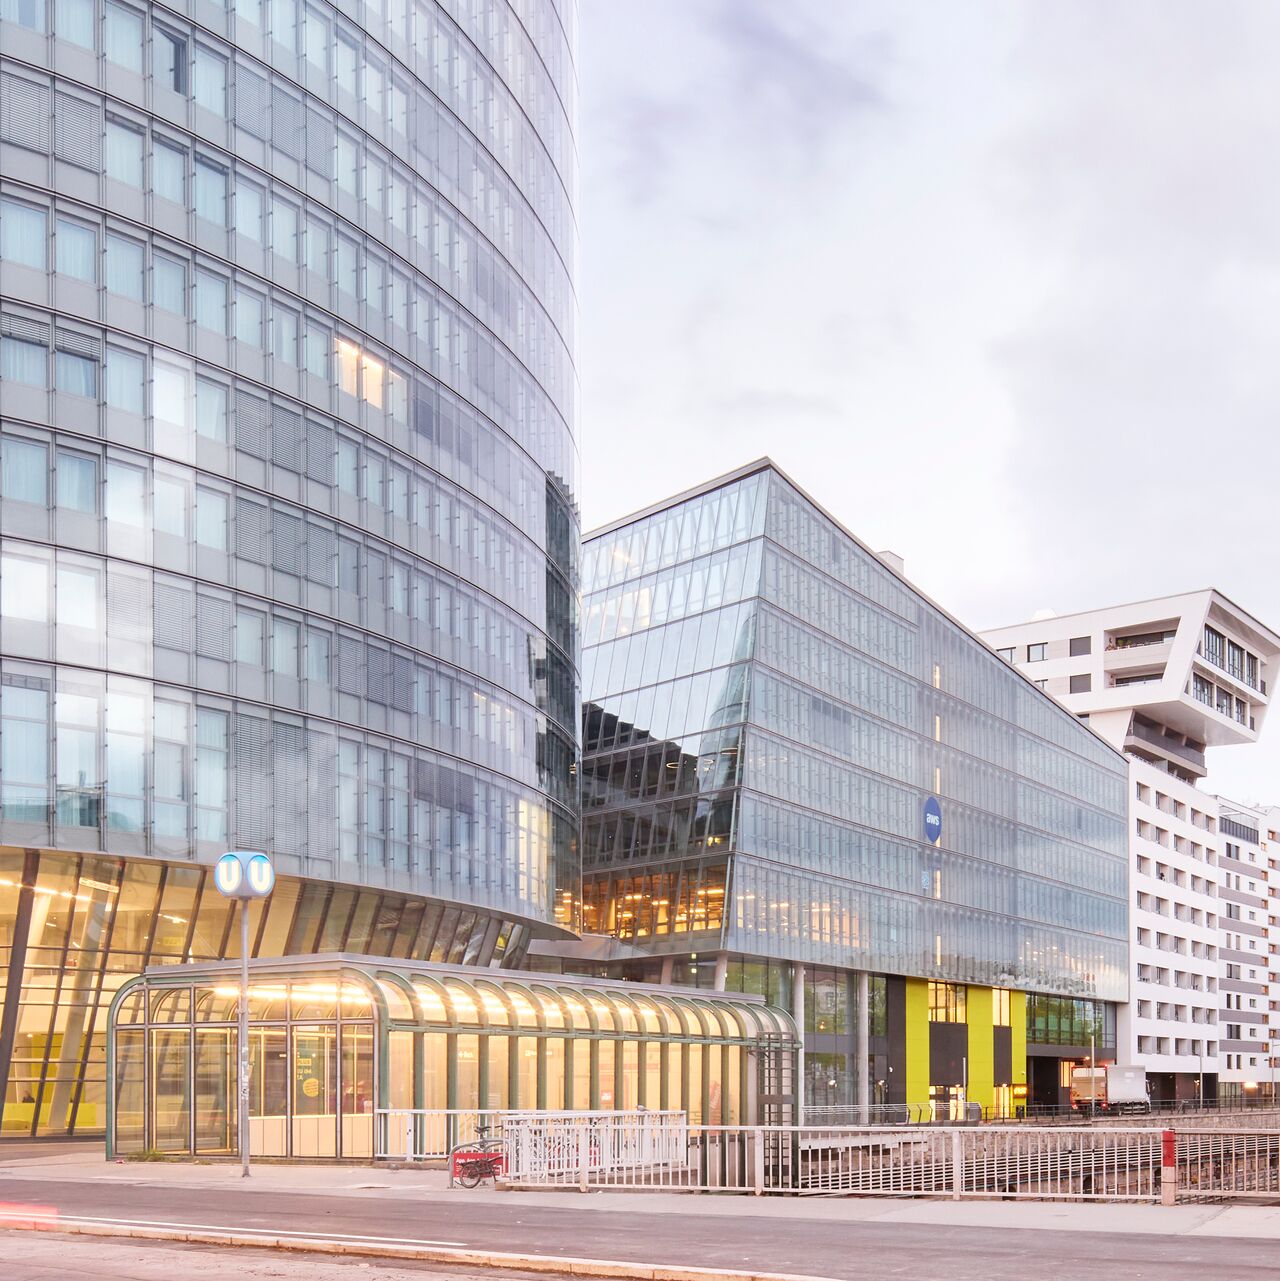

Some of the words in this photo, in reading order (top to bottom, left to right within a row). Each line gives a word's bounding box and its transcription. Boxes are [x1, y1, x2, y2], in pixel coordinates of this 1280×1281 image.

[926, 812, 940, 826] aws
[218, 860, 240, 892] U
[250, 860, 271, 892] U
